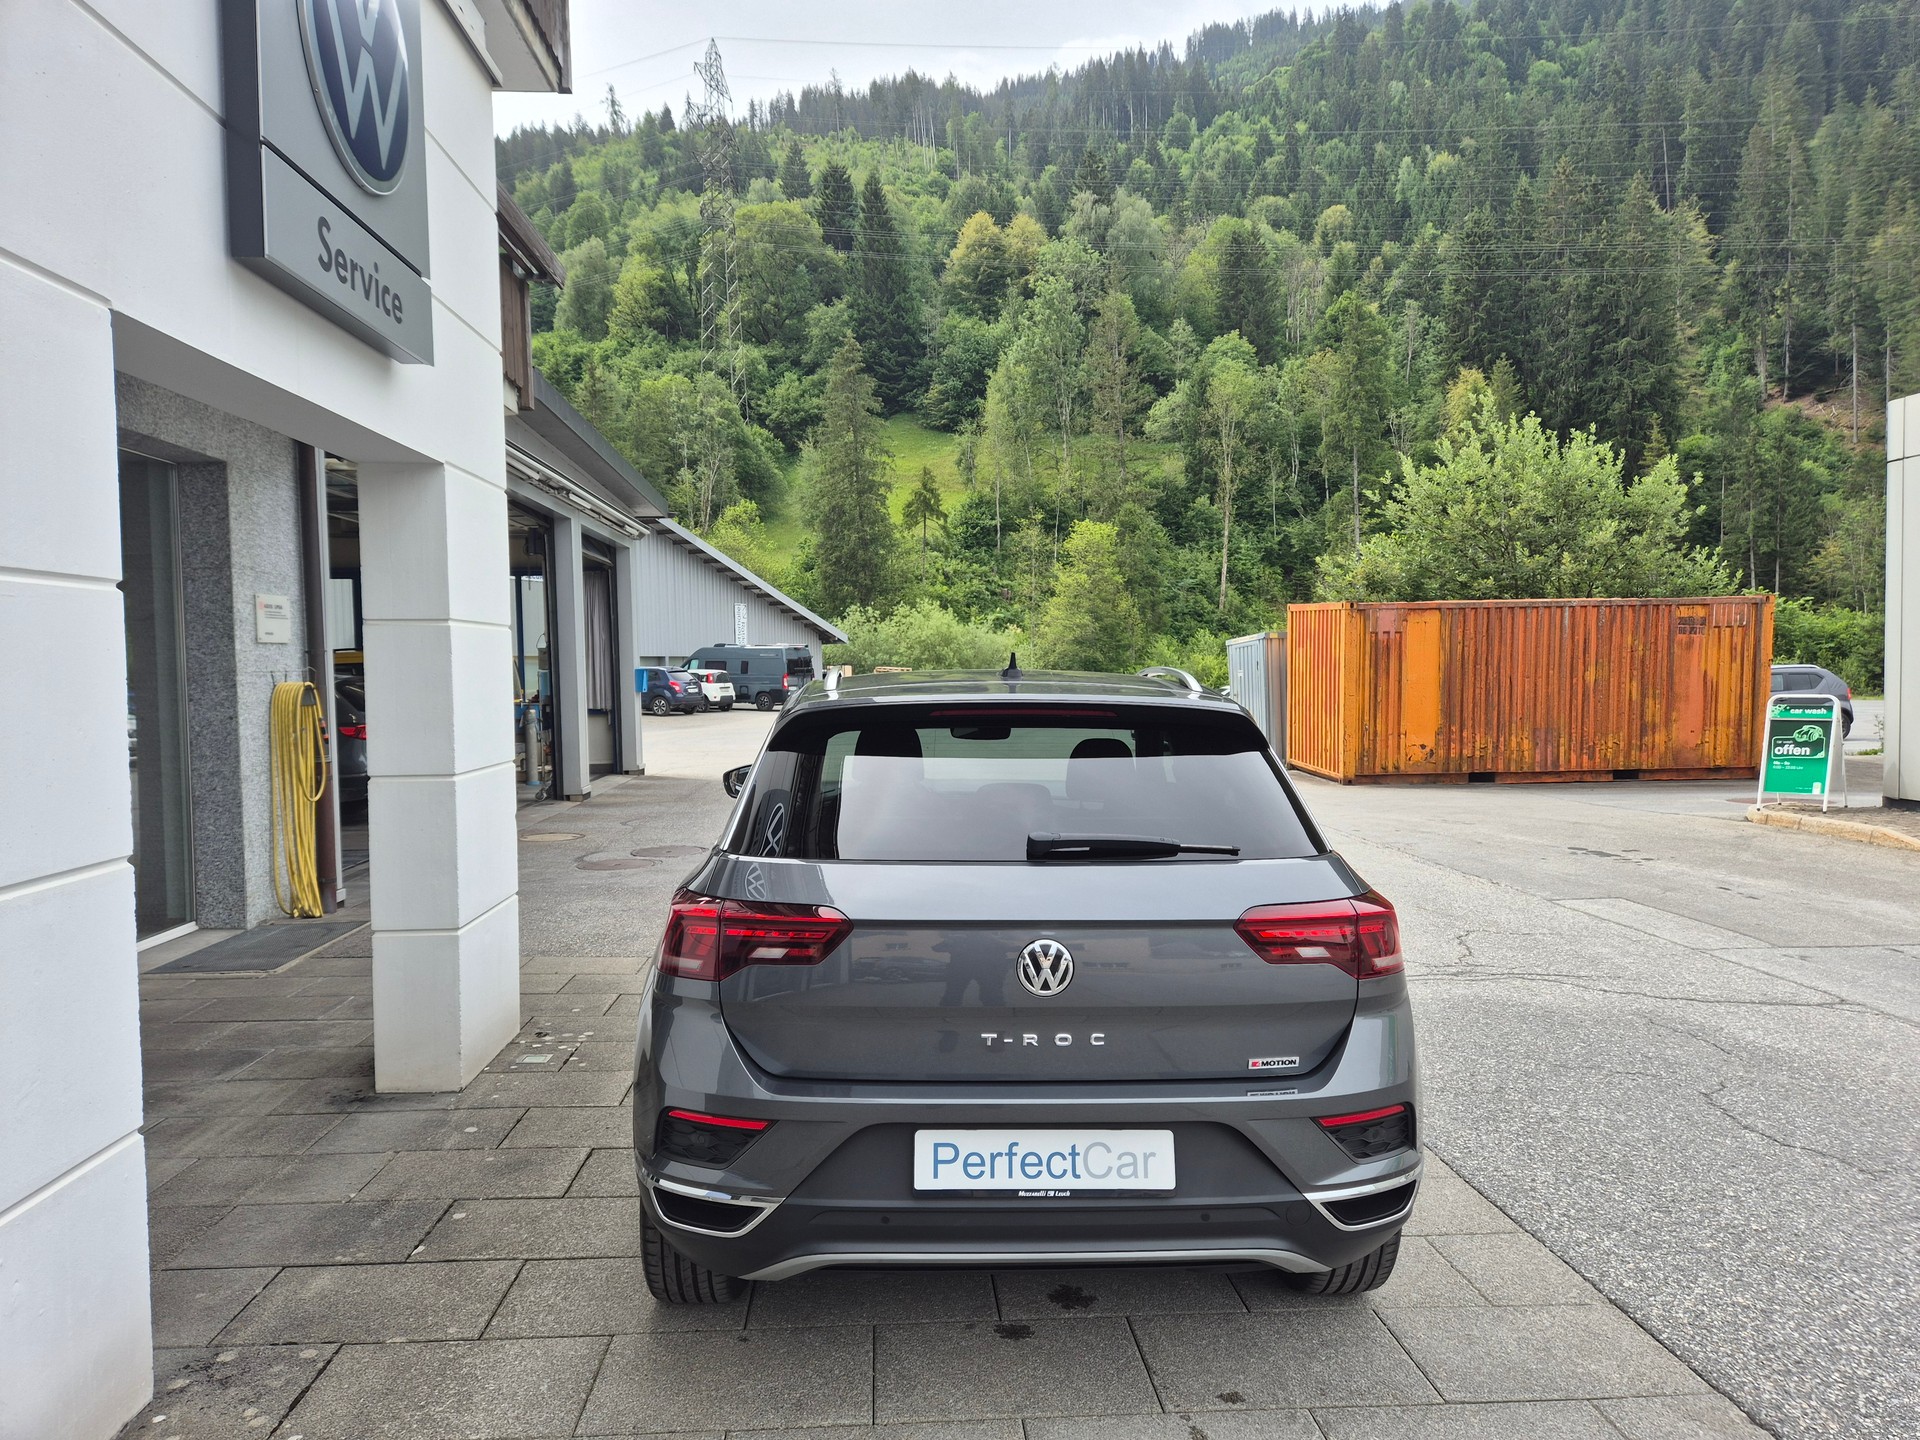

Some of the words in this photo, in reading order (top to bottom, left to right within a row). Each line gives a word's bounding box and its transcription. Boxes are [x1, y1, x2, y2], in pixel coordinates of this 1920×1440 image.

[317, 215, 403, 324] Service
[1774, 744, 1811, 756] offen
[932, 1141, 1157, 1180] PerfectCar
